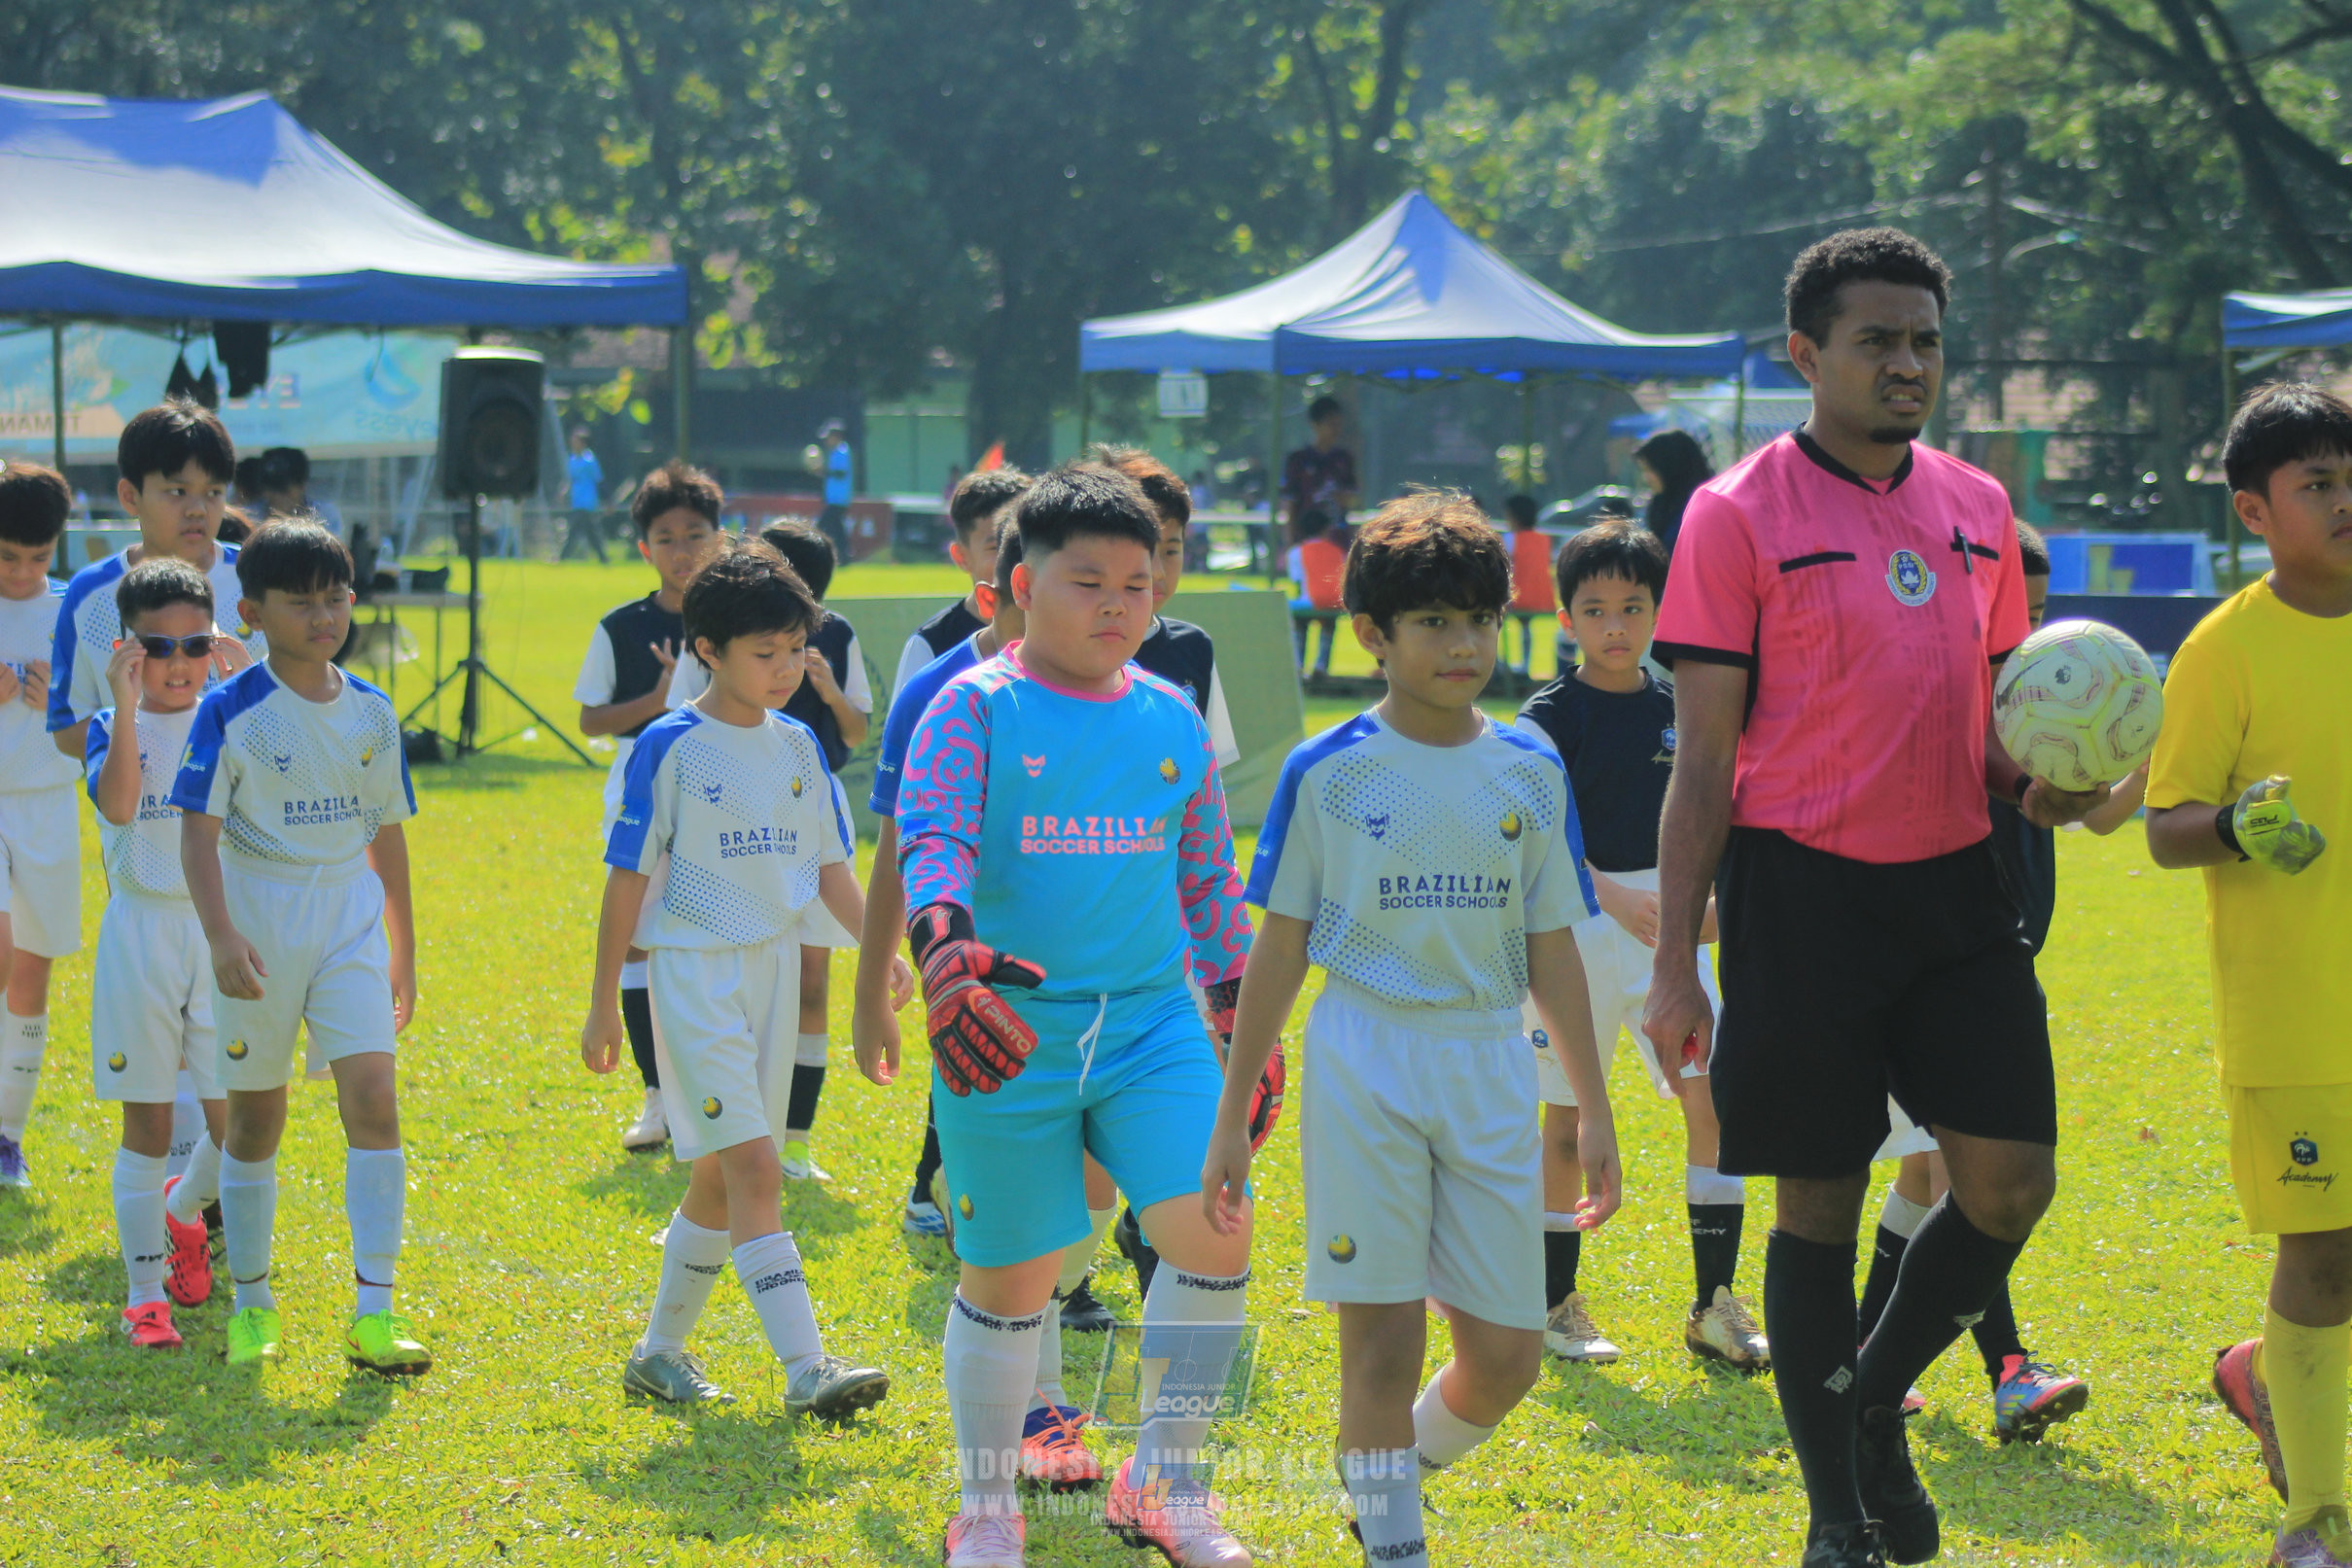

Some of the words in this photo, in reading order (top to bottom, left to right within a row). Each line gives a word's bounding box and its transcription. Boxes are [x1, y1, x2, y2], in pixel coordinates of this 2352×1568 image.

[284, 814, 332, 826] SOCCER
[720, 843, 773, 859] SOCCER
[1021, 838, 1102, 854] SOCCER
[1379, 874, 1511, 894] BRAZILIAN
[1379, 894, 1443, 910] SOCCER
[985, 1004, 1032, 1054] PINTO
[2276, 1167, 2339, 1193] Academy
